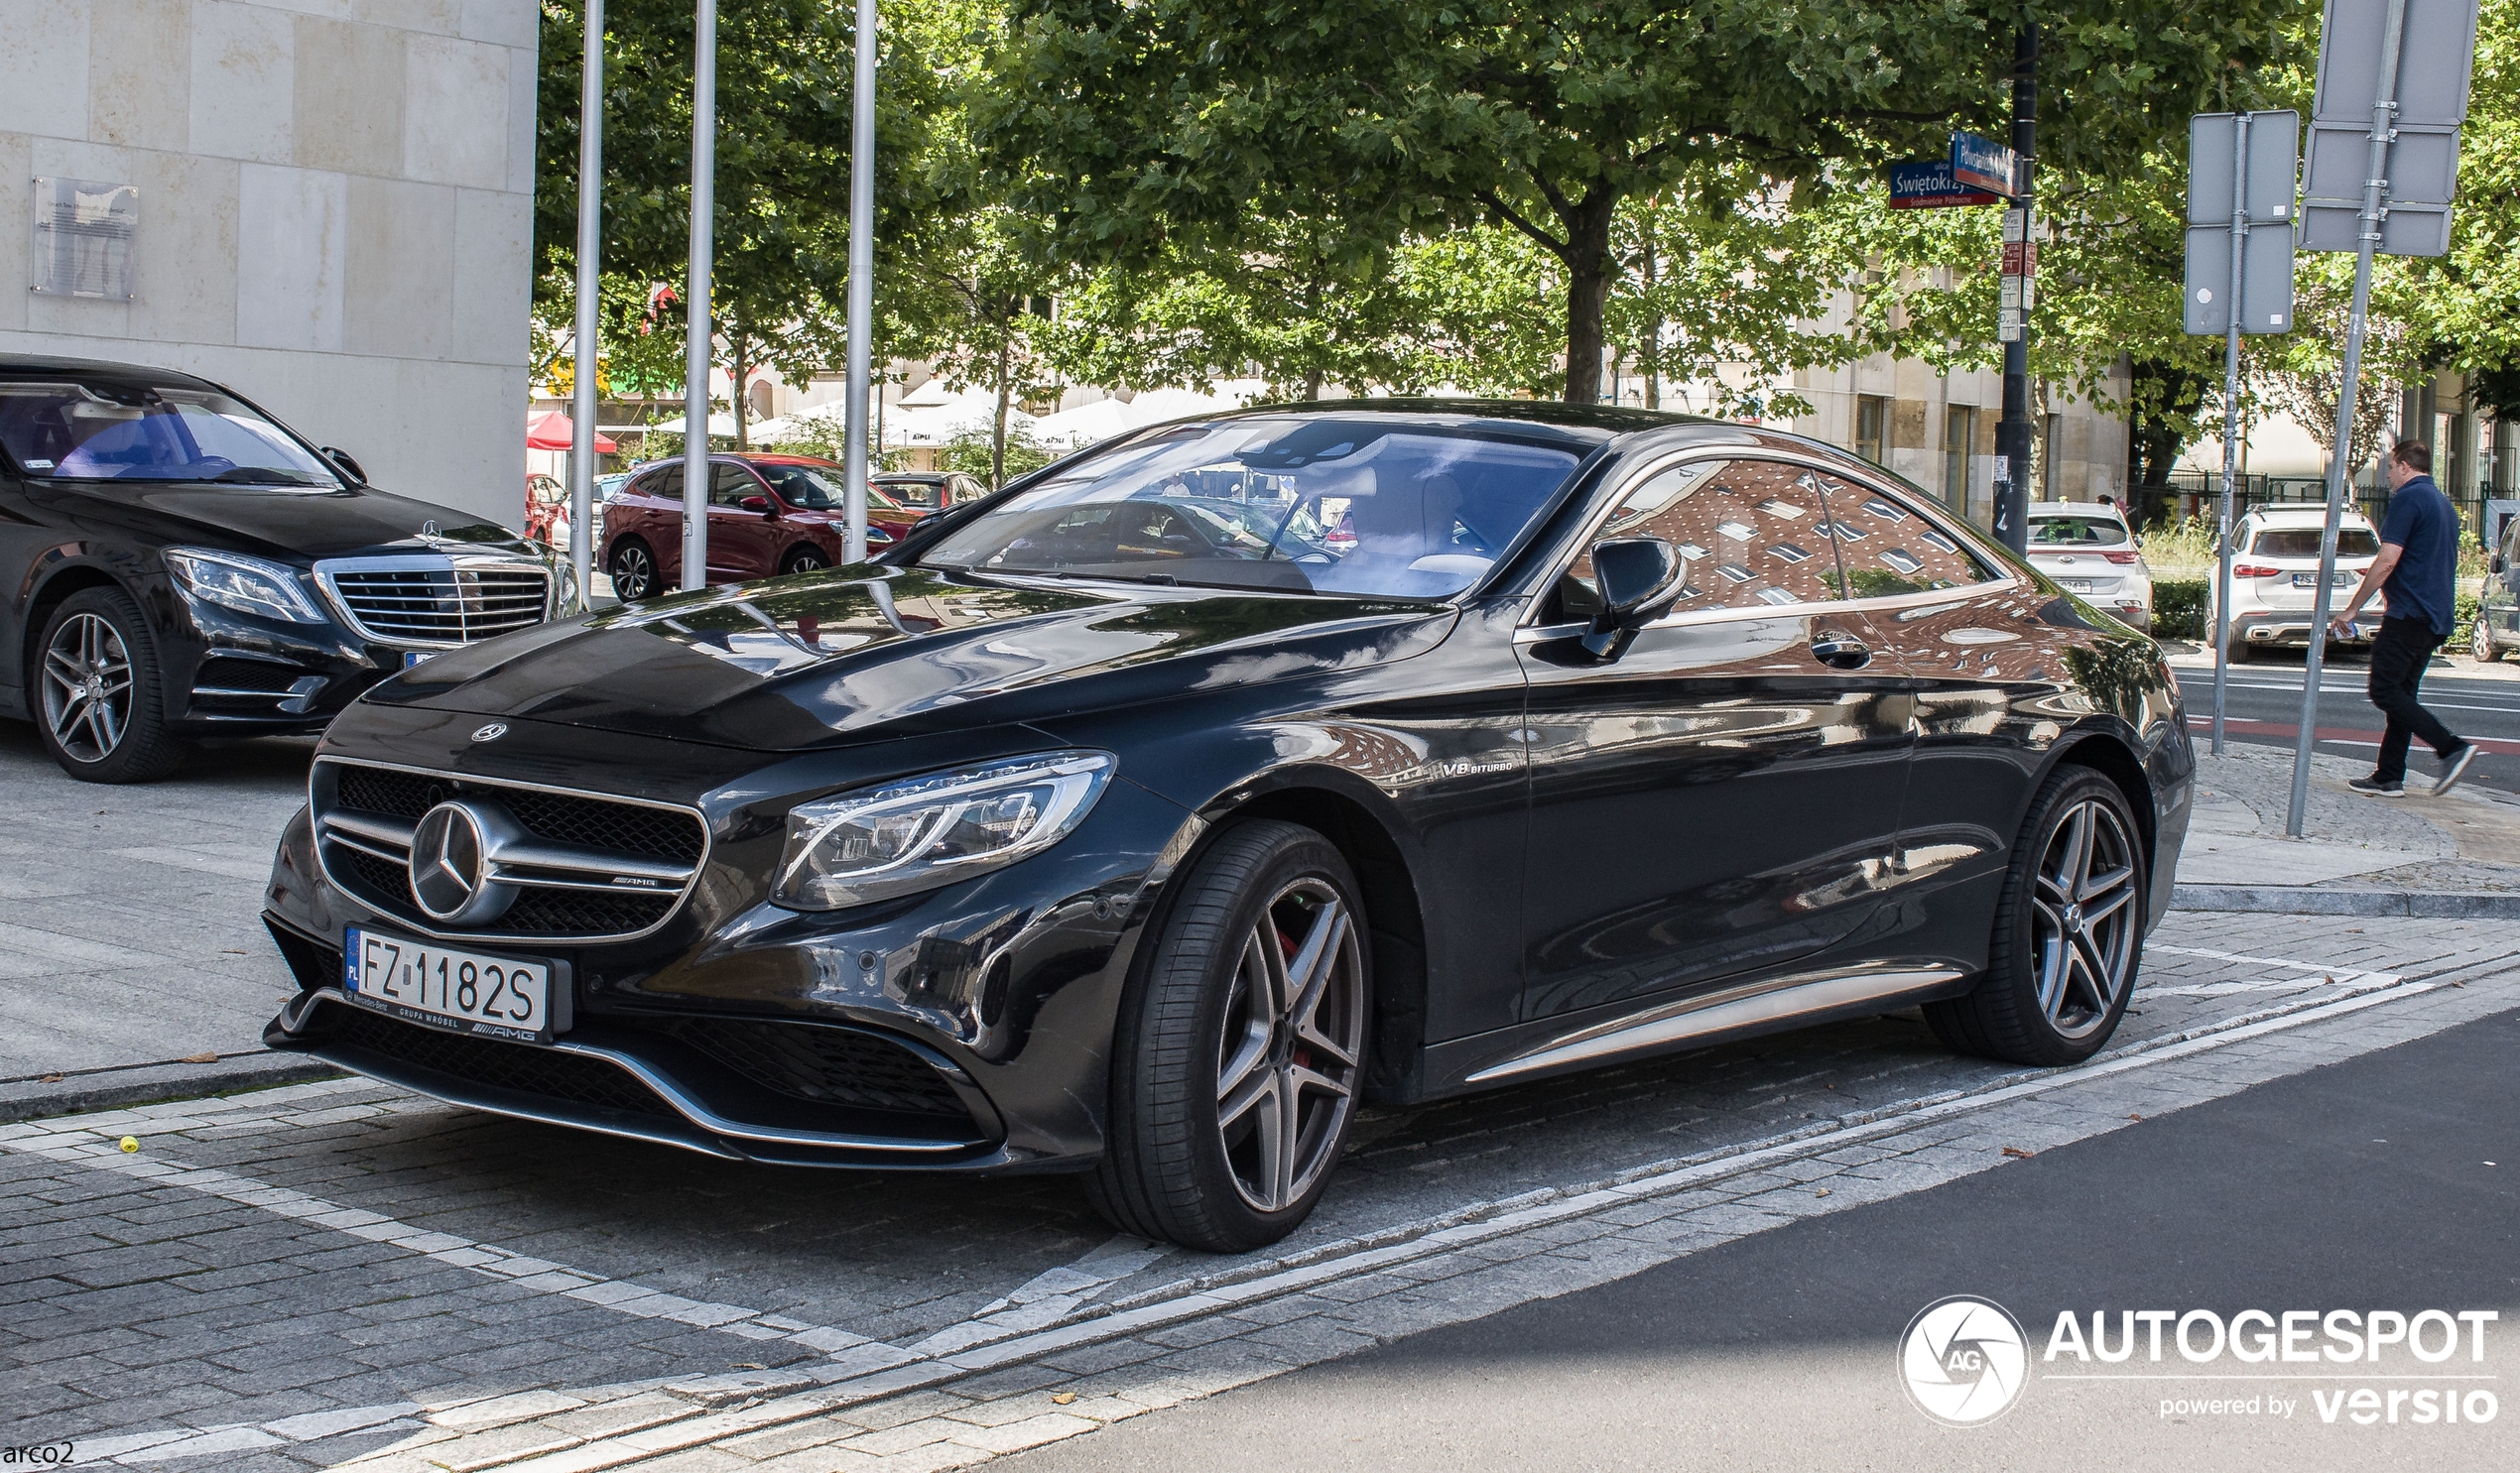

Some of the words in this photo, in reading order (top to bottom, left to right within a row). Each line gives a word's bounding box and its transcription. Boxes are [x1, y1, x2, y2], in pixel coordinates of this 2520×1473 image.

[1896, 172, 1968, 195] Świętokrzy
[1910, 197, 1943, 206] Śródmieście
[1945, 195, 1972, 204] Północne
[1443, 763, 1468, 776] V8
[1470, 763, 1512, 774] BITURBO
[348, 965, 359, 981] PL
[364, 938, 401, 998] FZ
[416, 951, 536, 1023] 1182S
[353, 994, 389, 1012] Mercedes-Benz
[399, 1008, 424, 1021] GRUPA
[426, 1014, 458, 1028] WRÓBEL
[490, 1026, 536, 1042] AMG
